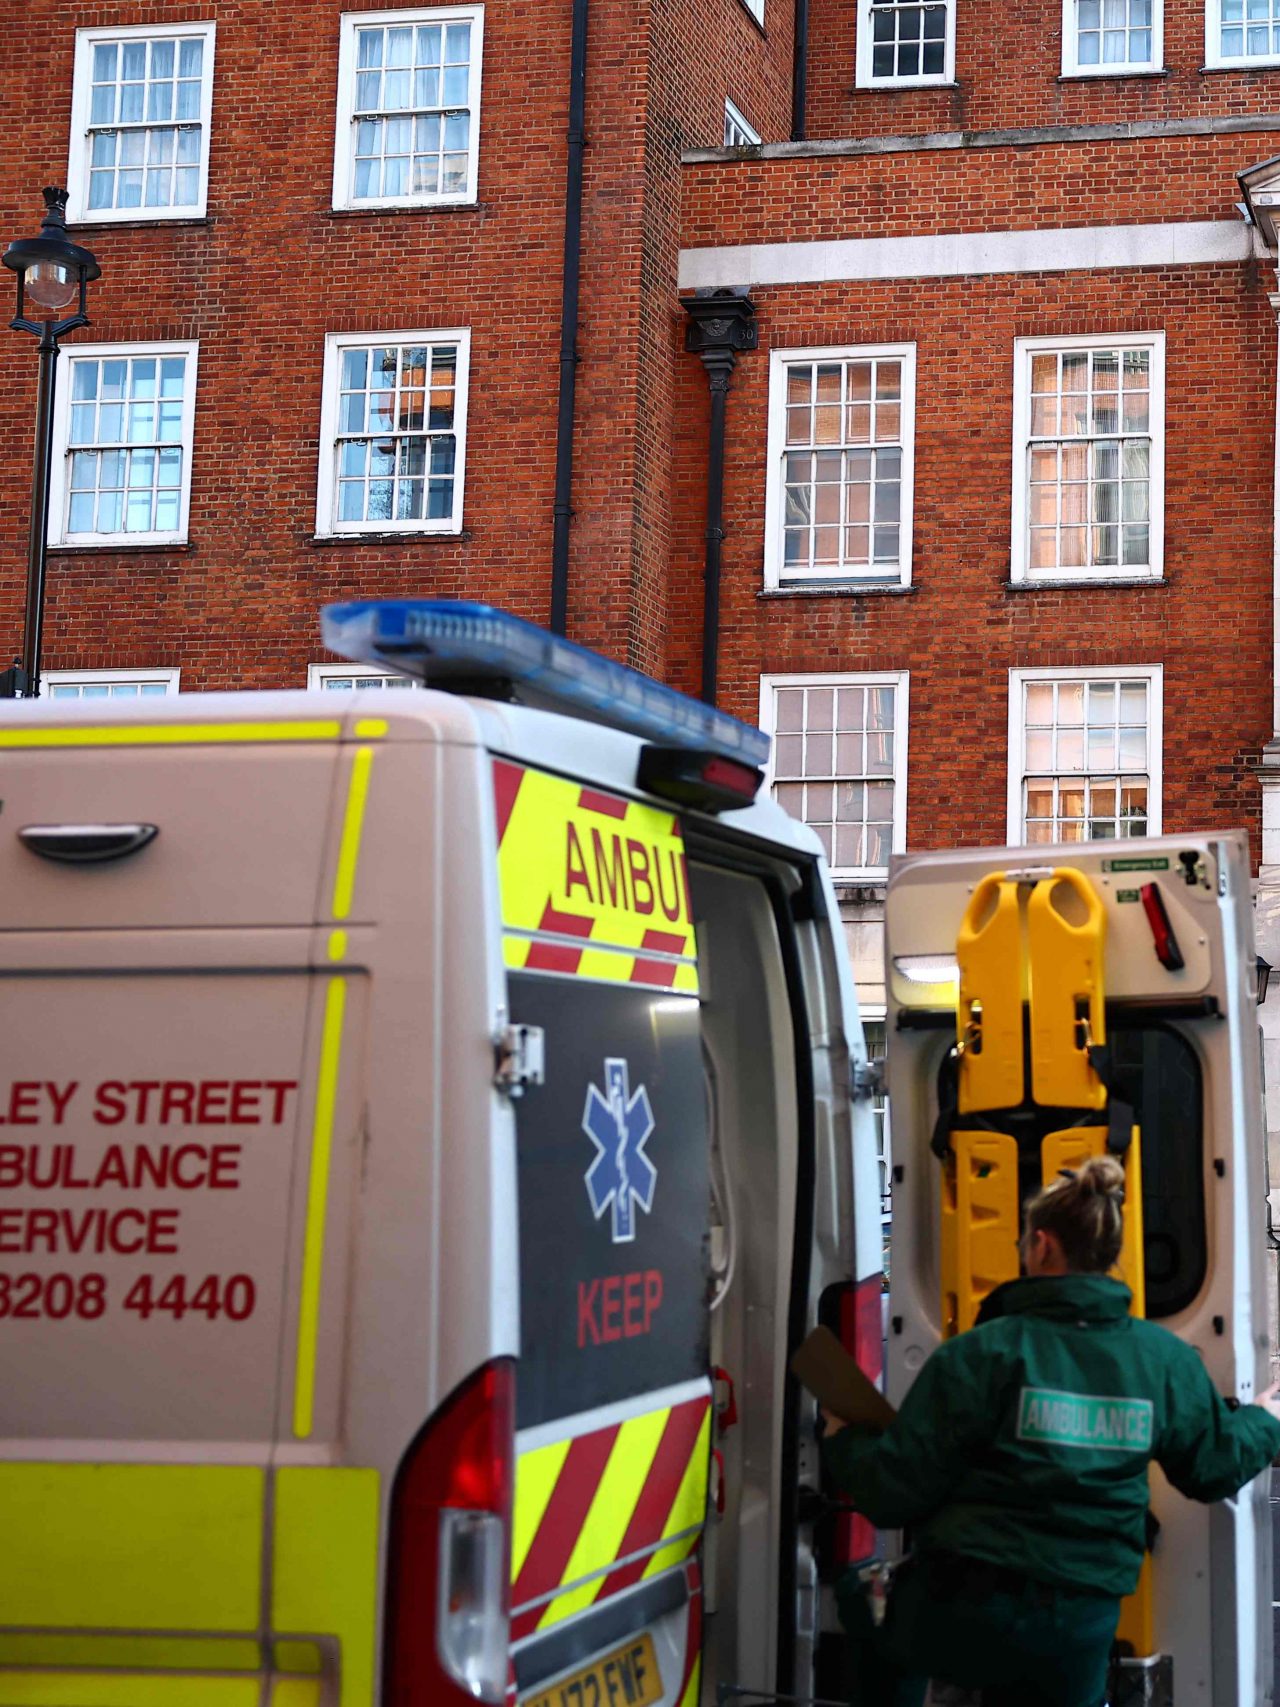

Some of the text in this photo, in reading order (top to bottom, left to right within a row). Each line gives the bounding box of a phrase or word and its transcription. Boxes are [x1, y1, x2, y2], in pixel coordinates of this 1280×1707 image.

[0, 1079, 298, 1126] EY STREET
[0, 1207, 181, 1255] ERVICE
[122, 1273, 257, 1321] 4440
[577, 1269, 664, 1349] KEEP
[1024, 1398, 1150, 1442] AMBULANCE
